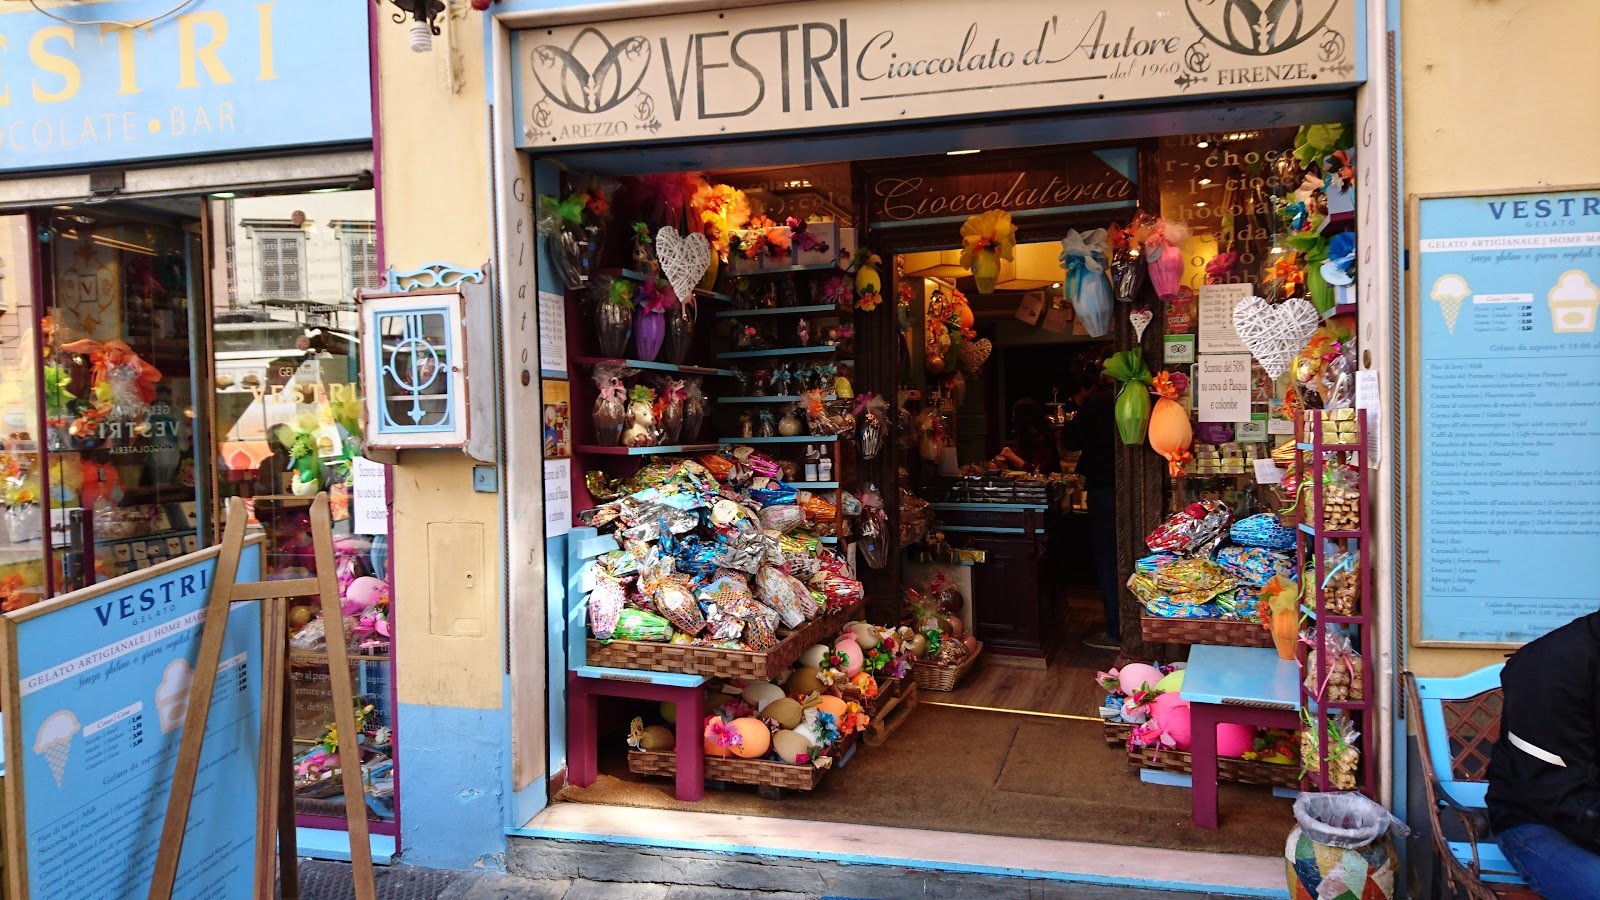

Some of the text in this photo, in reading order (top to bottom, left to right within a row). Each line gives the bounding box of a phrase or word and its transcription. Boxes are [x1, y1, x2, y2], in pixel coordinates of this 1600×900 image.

[0, 3, 281, 106] STRI
[855, 10, 1181, 83] Cioccolato d'Autore
[659, 17, 849, 122] VESTRI
[1109, 60, 1180, 80] dal 1960
[0, 101, 236, 151] COLATE BAR
[559, 119, 629, 141] AREZZO
[874, 171, 1136, 221] Cioccolateria
[1362, 112, 1374, 342] Gelato
[1526, 219, 1576, 229] GELATO
[1428, 240, 1468, 250] GELATO
[1470, 238, 1539, 249] ARTIGIANALE
[1549, 235, 1583, 245] HOME
[512, 177, 529, 364] Gelato
[1204, 360, 1245, 373] Sconto del 50%
[251, 382, 358, 405] VESTRI
[1201, 378, 1248, 393] su uova di Pasqua
[1210, 398, 1238, 410] e colombe
[93, 569, 208, 627] VESTRI
[131, 604, 176, 627] GELATO
[27, 663, 75, 690] GELATO
[78, 632, 146, 671] ARTIGIANALE
[154, 619, 182, 637] HOME
